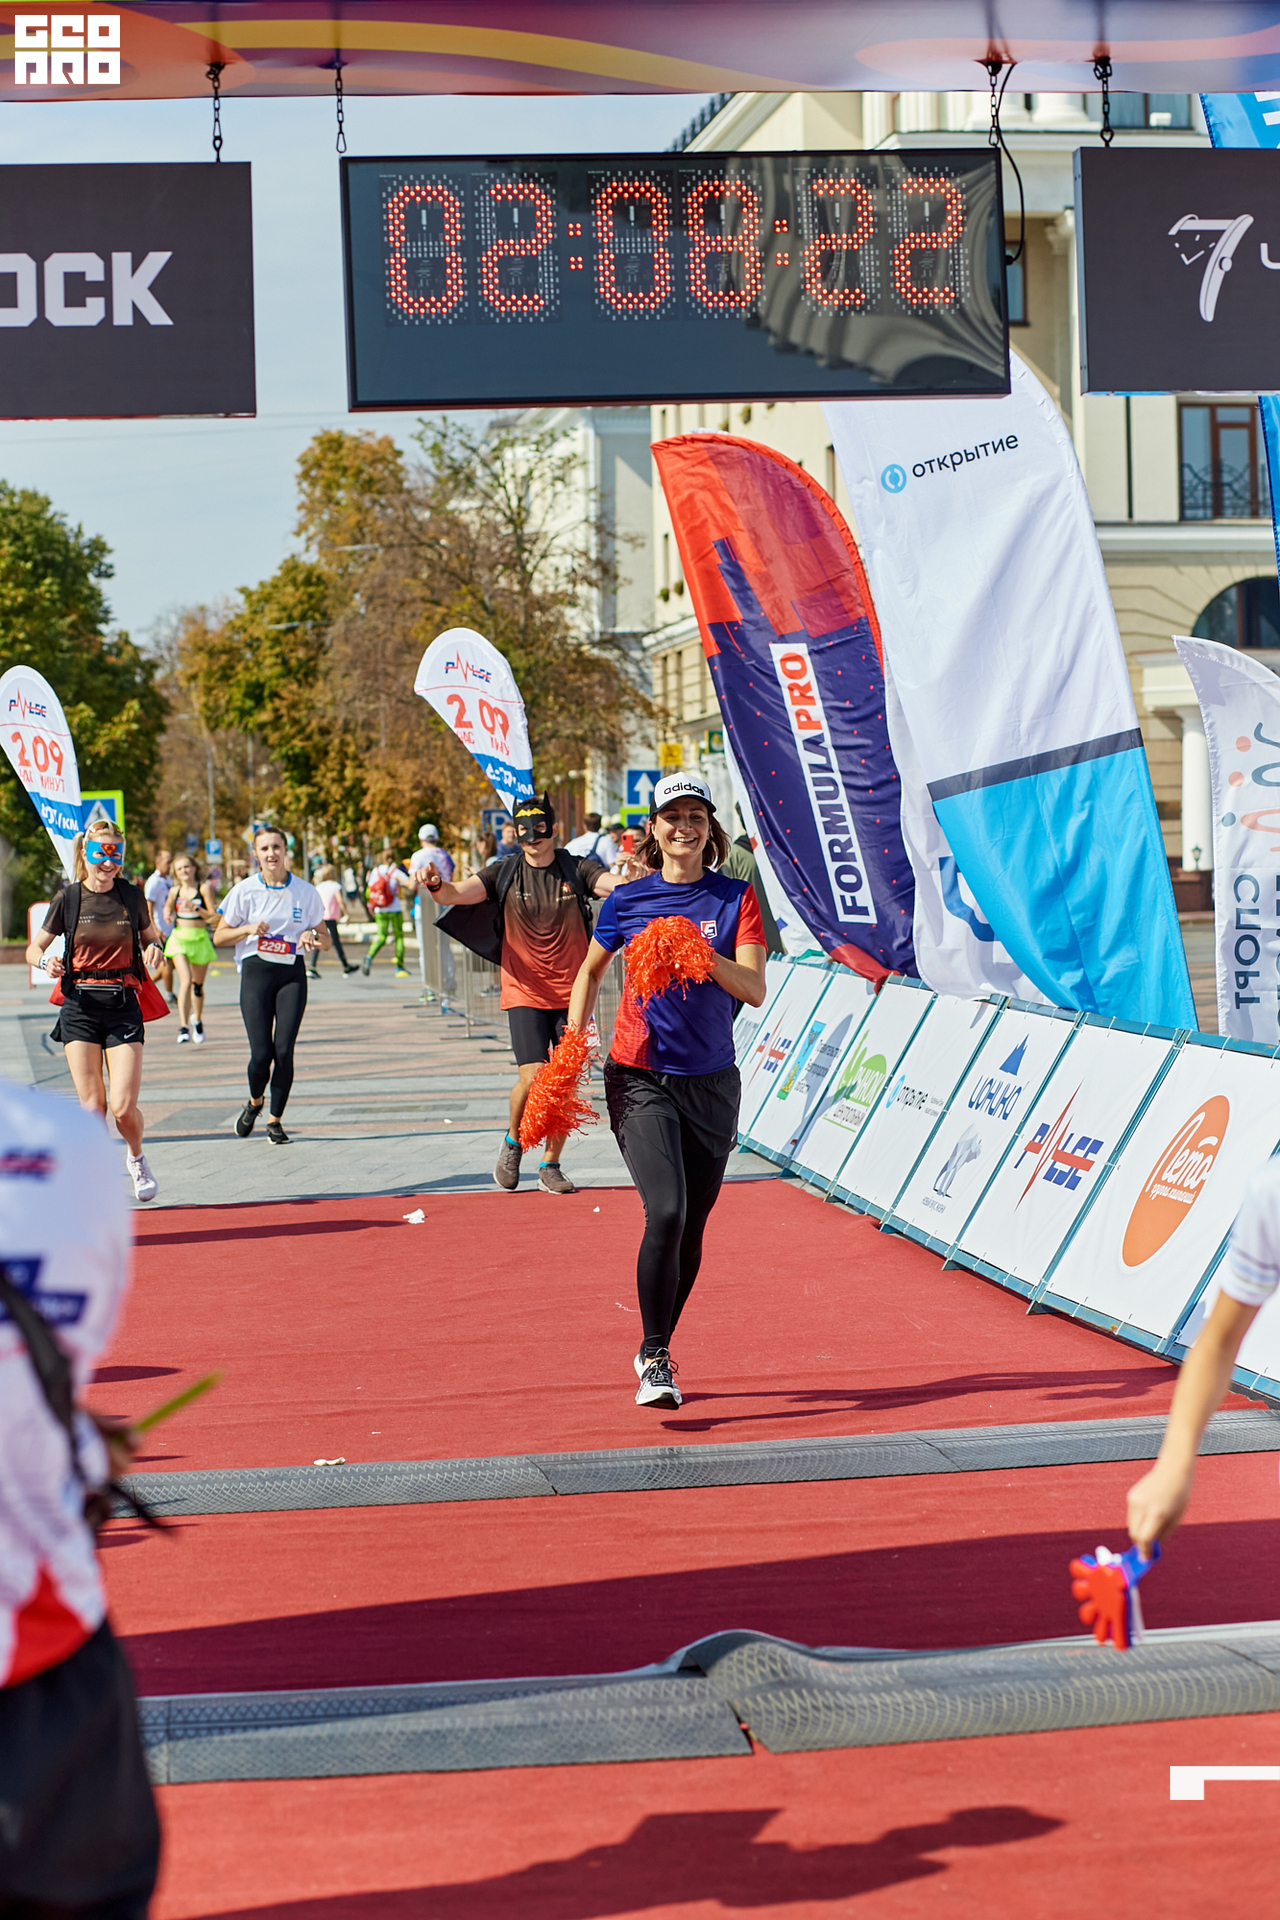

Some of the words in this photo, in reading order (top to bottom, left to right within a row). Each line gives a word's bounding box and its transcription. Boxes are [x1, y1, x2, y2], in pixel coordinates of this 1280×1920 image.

[388, 178, 963, 313] 02:08:22
[912, 434, 1019, 477] открытие
[663, 782, 706, 797] adidas
[260, 940, 287, 954] 2291
